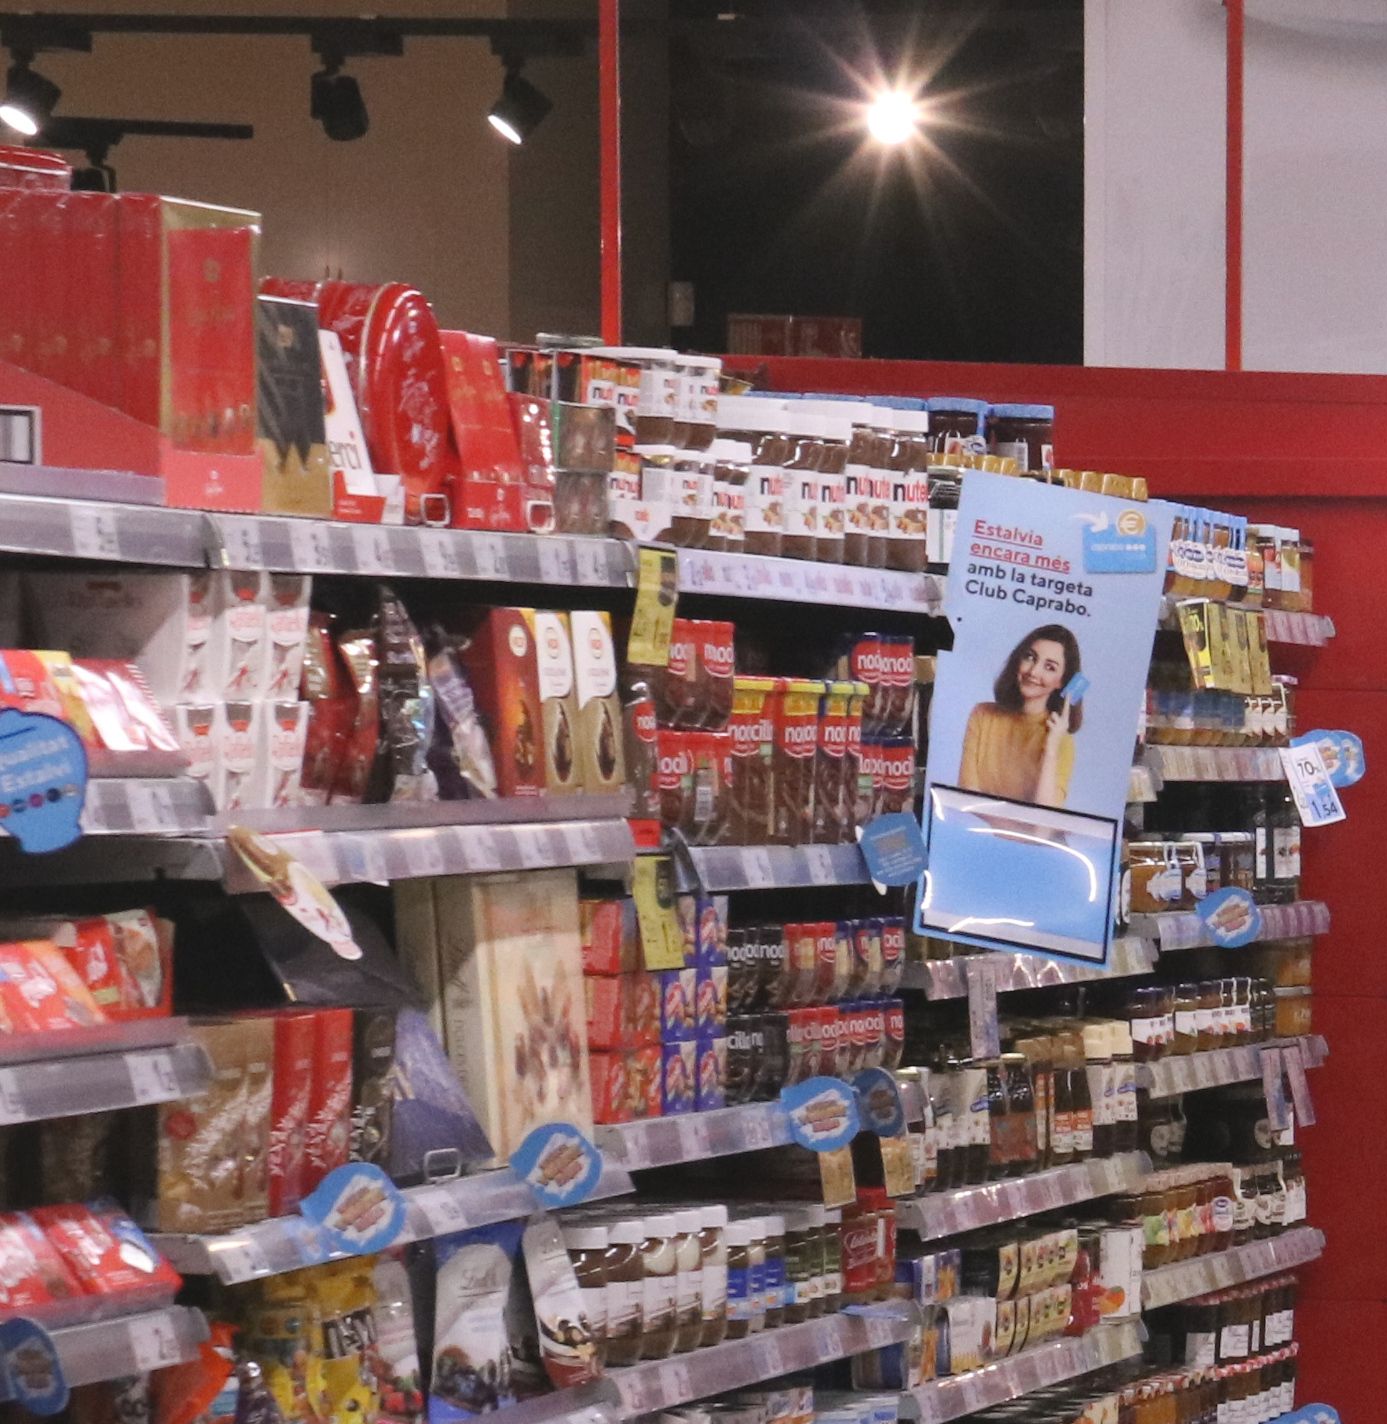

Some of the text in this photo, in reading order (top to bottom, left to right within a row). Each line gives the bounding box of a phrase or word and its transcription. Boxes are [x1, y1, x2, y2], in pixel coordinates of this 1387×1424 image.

[974, 519, 1043, 546] Estalvia
[970, 542, 1071, 574] encara més
[967, 563, 1093, 598] amb la targeta
[964, 579, 1092, 617] Club Caprabo.
[0, 735, 70, 768] ualitat
